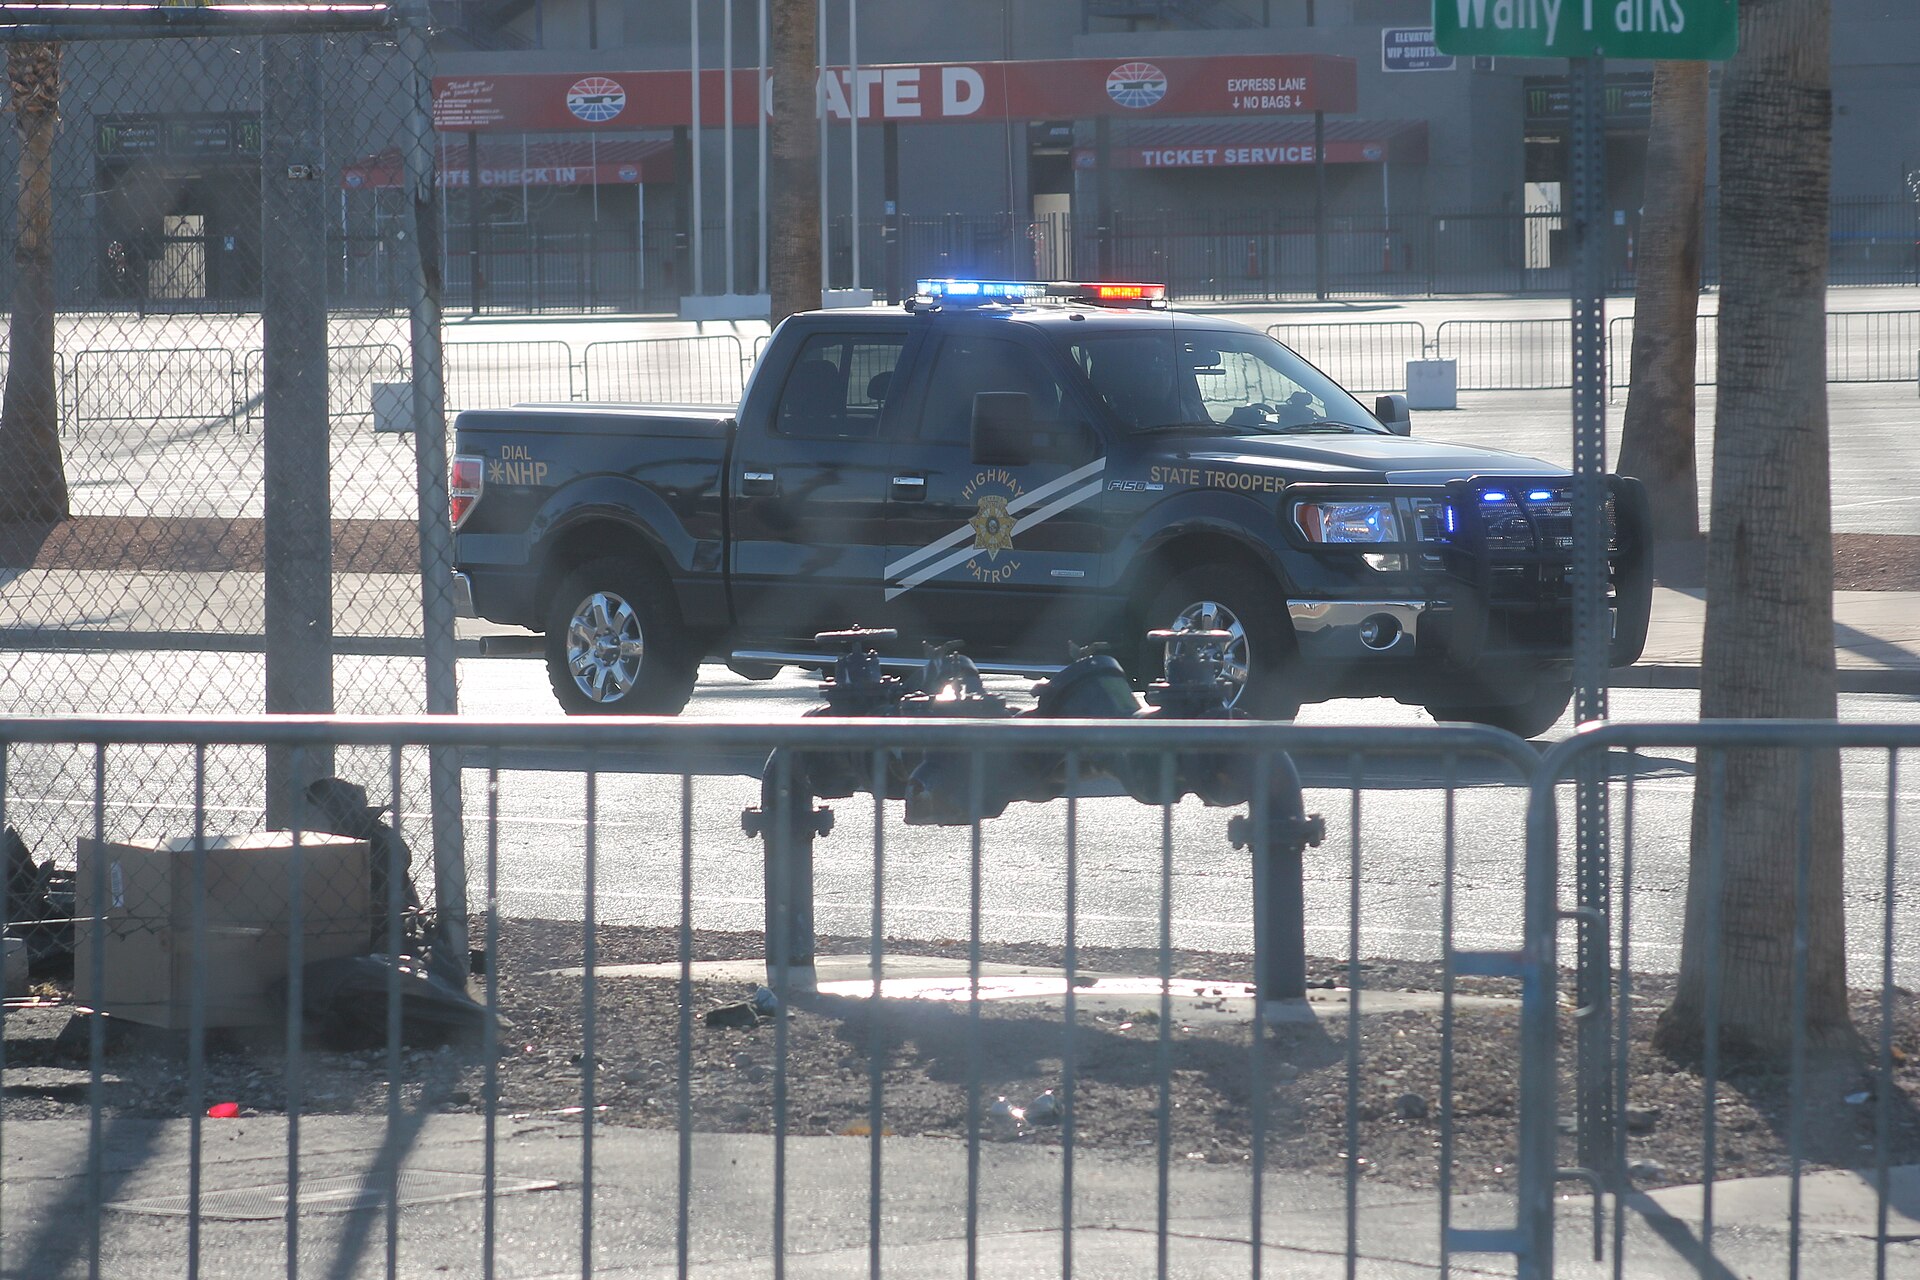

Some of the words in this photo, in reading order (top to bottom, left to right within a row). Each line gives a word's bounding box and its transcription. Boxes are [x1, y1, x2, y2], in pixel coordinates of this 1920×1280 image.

[1387, 47, 1403, 58] VIP
[1404, 46, 1436, 58] SUITES
[766, 68, 922, 118] ATE
[943, 66, 985, 116] D
[1227, 78, 1276, 92] EXPRESS
[1278, 77, 1307, 91] LANE
[1243, 96, 1259, 109] NO
[1261, 95, 1291, 109] BAGS
[1142, 149, 1217, 165] TICKET
[479, 168, 549, 184] CHECK
[555, 167, 577, 182] IN
[501, 445, 532, 460] DIAL
[962, 468, 1025, 500] HIGHWAY
[1150, 466, 1200, 485] STATE
[1204, 470, 1287, 493] TROOPER
[966, 558, 1021, 583] PATROL
